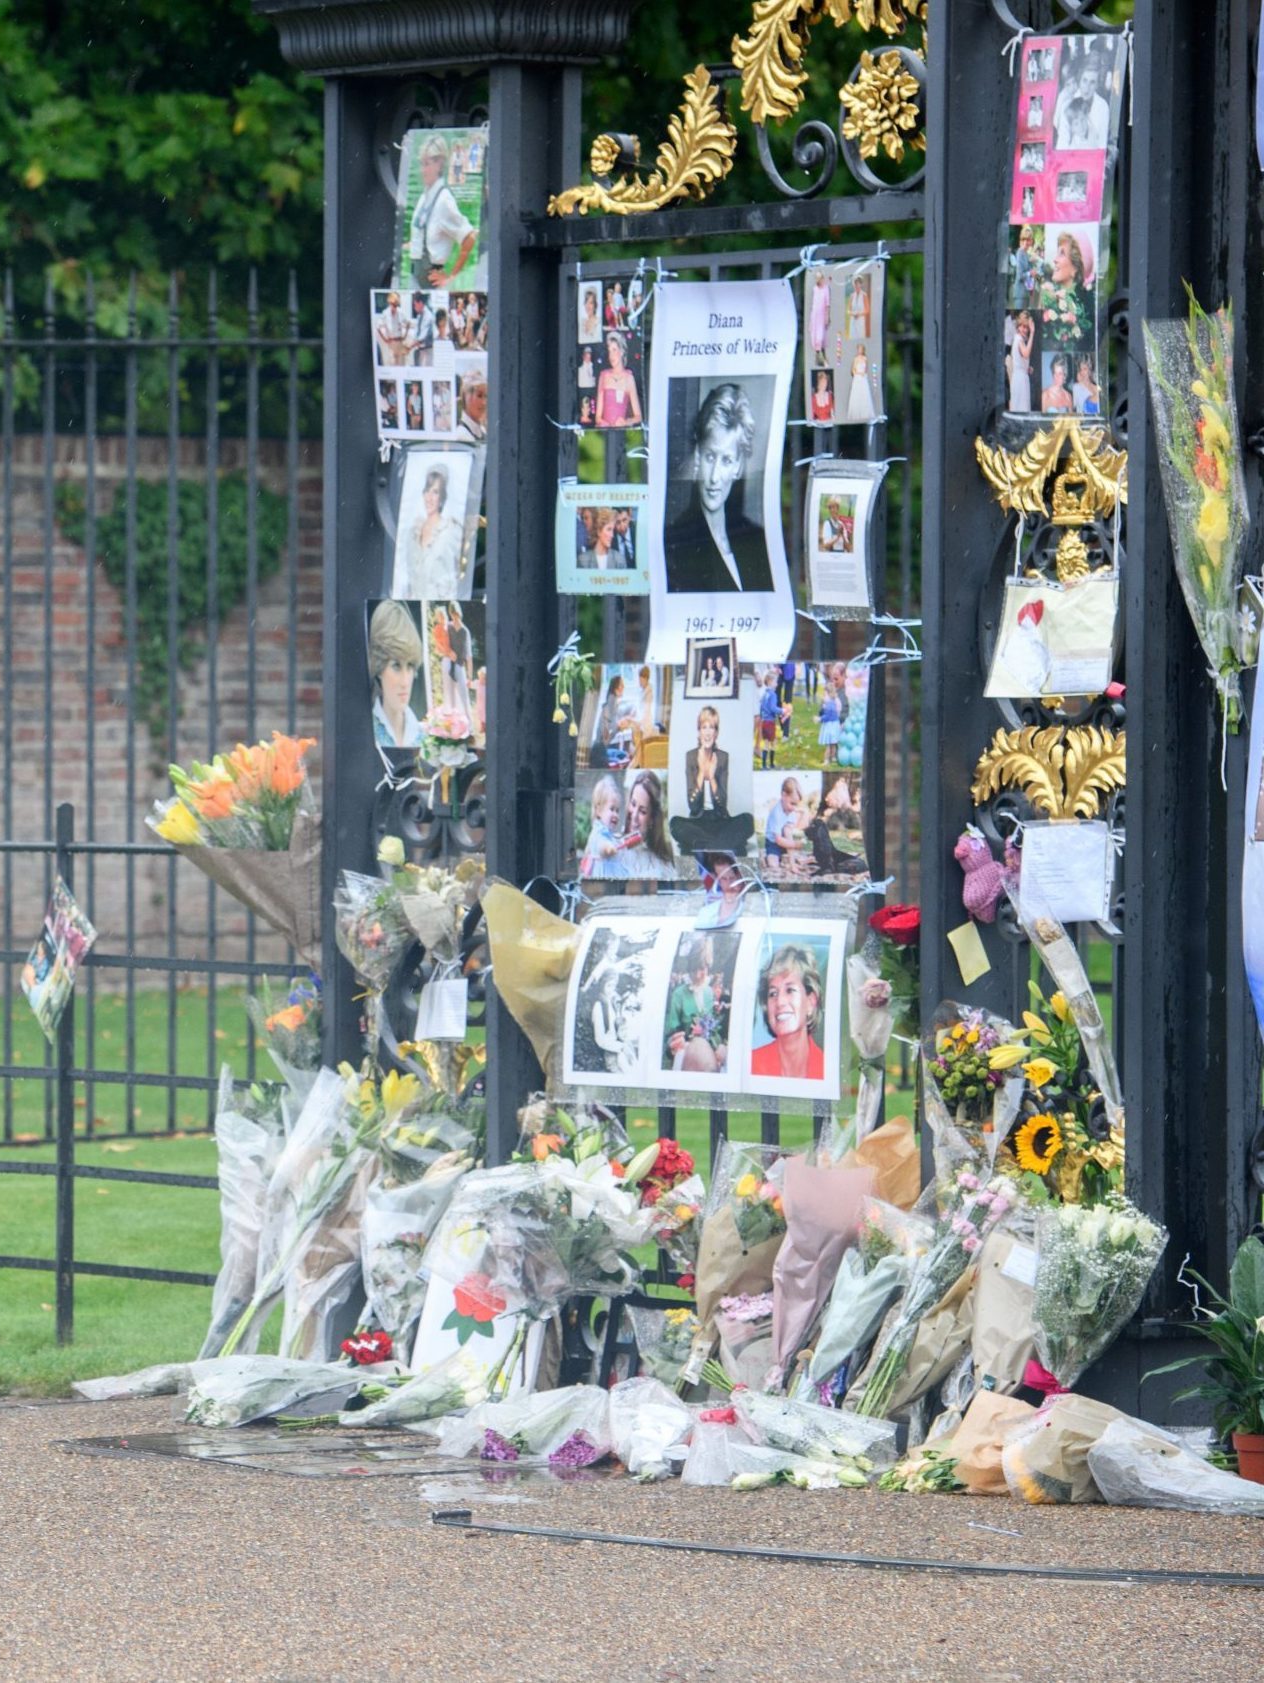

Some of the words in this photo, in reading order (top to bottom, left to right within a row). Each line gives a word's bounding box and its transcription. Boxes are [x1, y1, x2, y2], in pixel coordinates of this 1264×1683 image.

[708, 313, 744, 329] Diana
[671, 340, 723, 356] Princess
[726, 338, 741, 355] of
[744, 338, 779, 354] Wales
[685, 617, 715, 633] 1961
[729, 617, 761, 633] 1997
